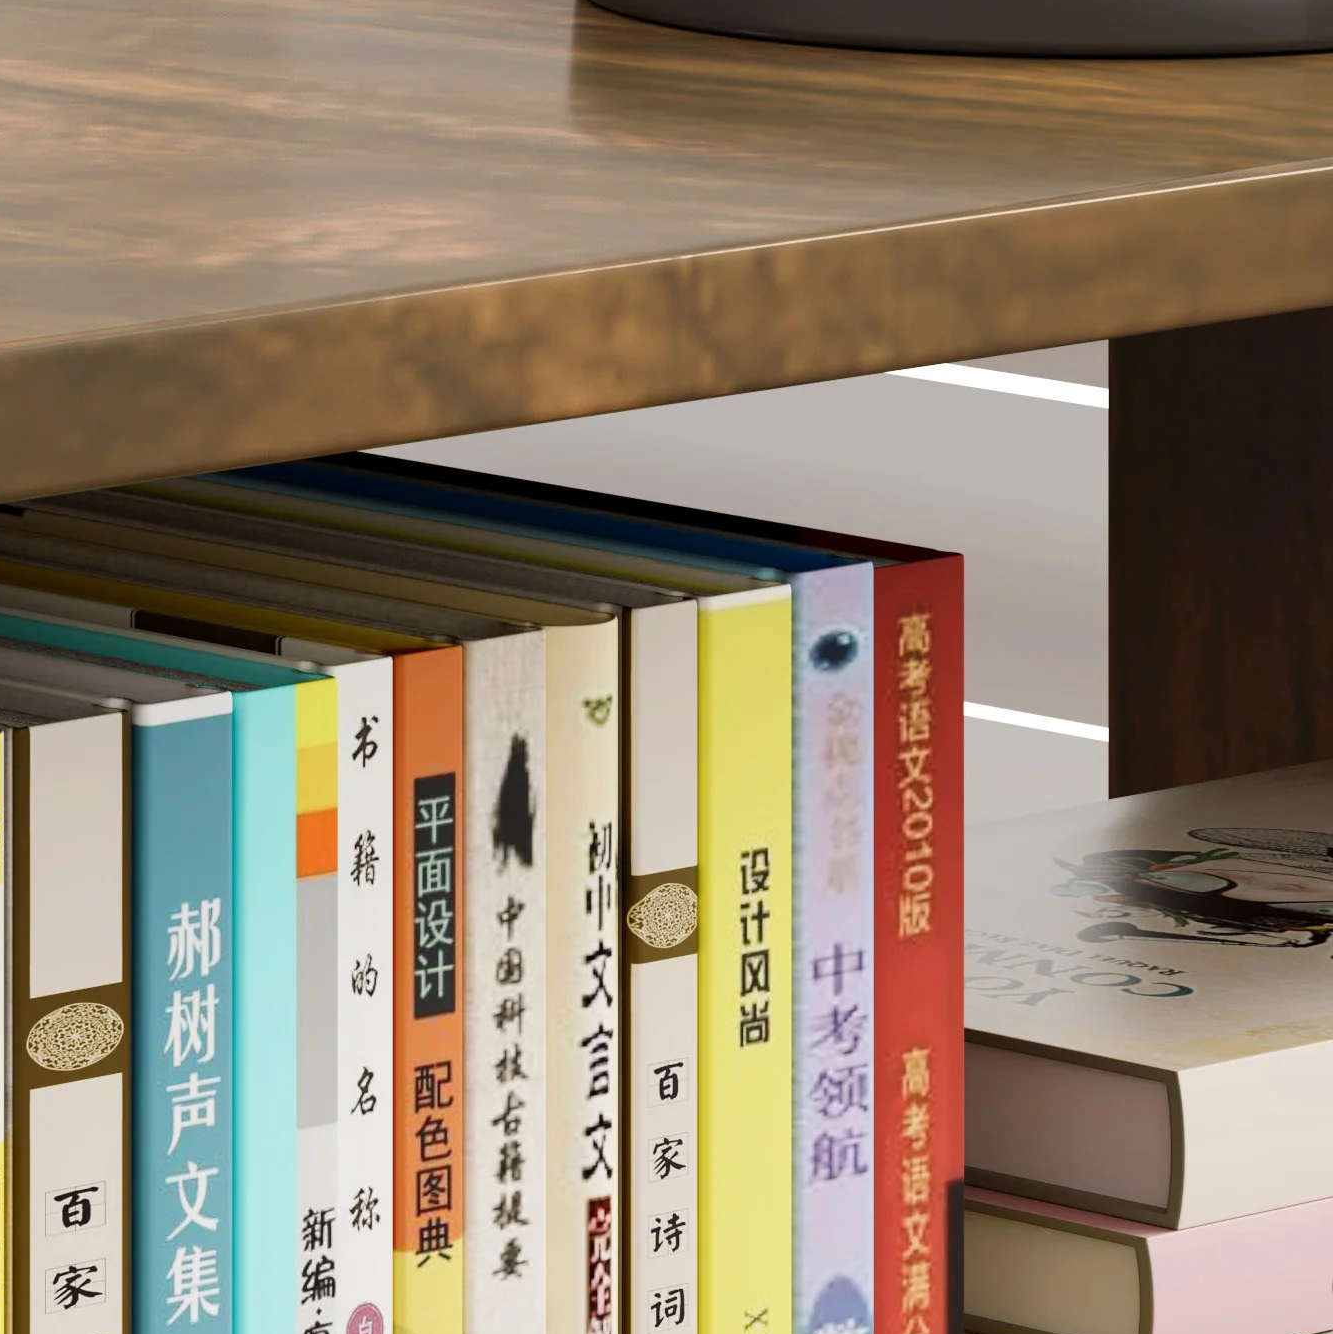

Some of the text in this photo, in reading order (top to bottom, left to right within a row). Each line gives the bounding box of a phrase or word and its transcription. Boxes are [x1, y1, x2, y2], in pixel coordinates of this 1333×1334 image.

[415, 796, 453, 999] 平面设计
[740, 847, 770, 1048] 设计风尚
[164, 897, 222, 1325] 郝树声文集
[415, 1061, 453, 1267] 配色图典
[810, 942, 868, 1181] 中考领航
[650, 1062, 686, 1329] 百家诗词
